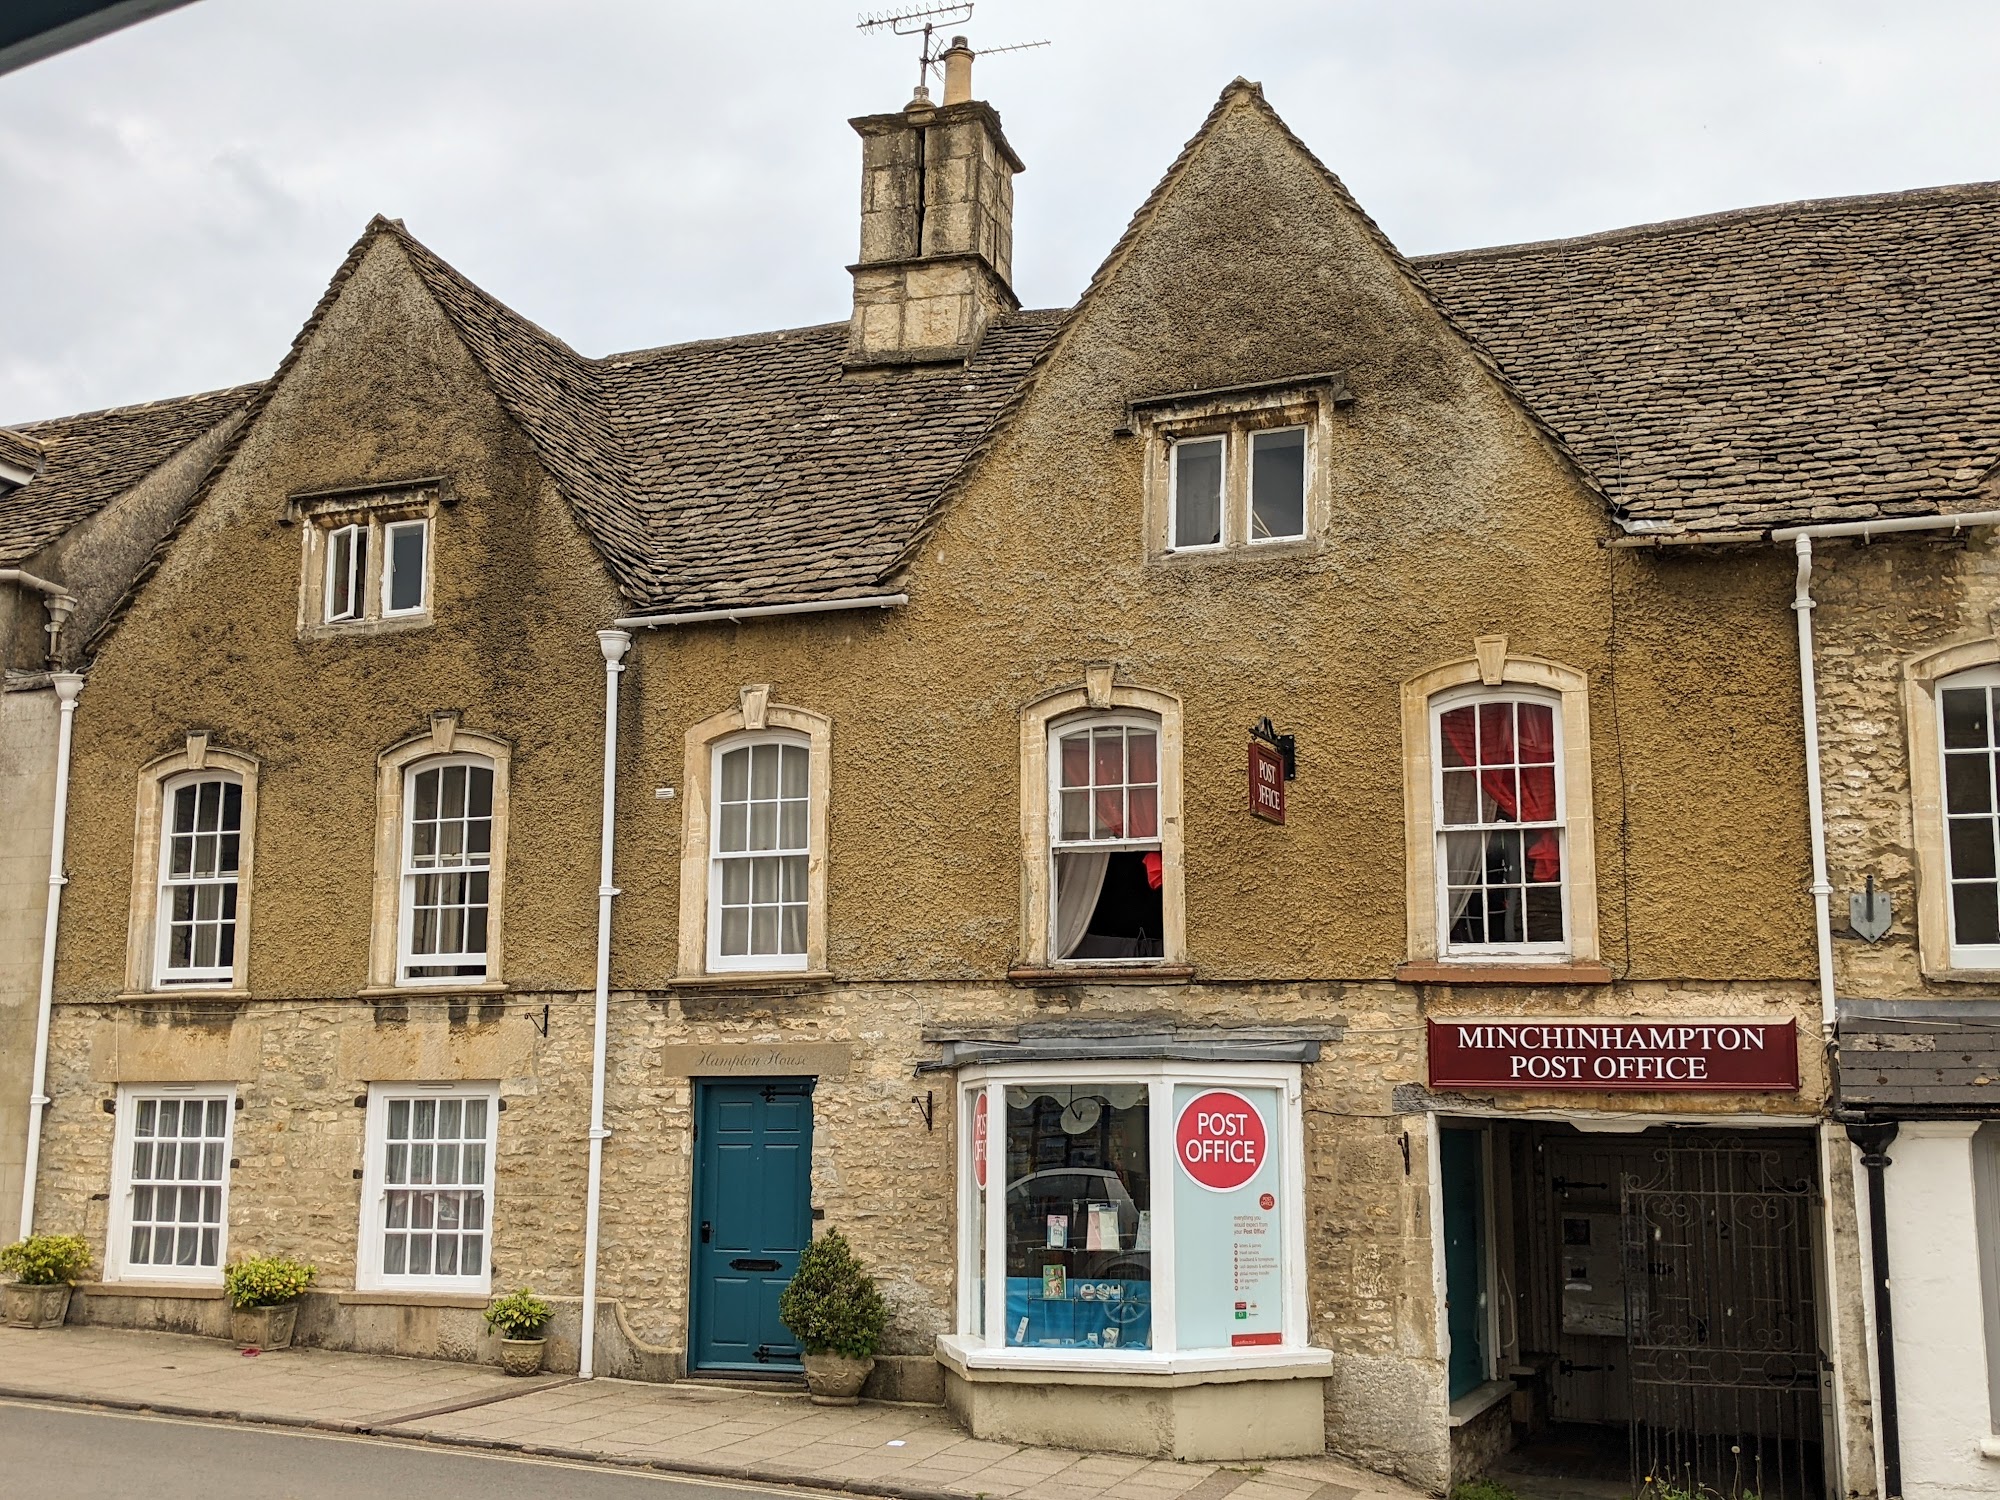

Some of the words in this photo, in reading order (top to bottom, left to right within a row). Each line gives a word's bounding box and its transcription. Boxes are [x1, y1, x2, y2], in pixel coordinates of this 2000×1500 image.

[1258, 759, 1276, 784] POST
[1457, 1026, 1765, 1051] MINCHINHAMPTON
[695, 1049, 761, 1072] Hampton
[763, 1049, 809, 1066] House
[1509, 1055, 1586, 1079] POST
[1593, 1055, 1708, 1080] OFFICE
[1197, 1112, 1248, 1136] POST
[1186, 1139, 1256, 1164] OFFICE
